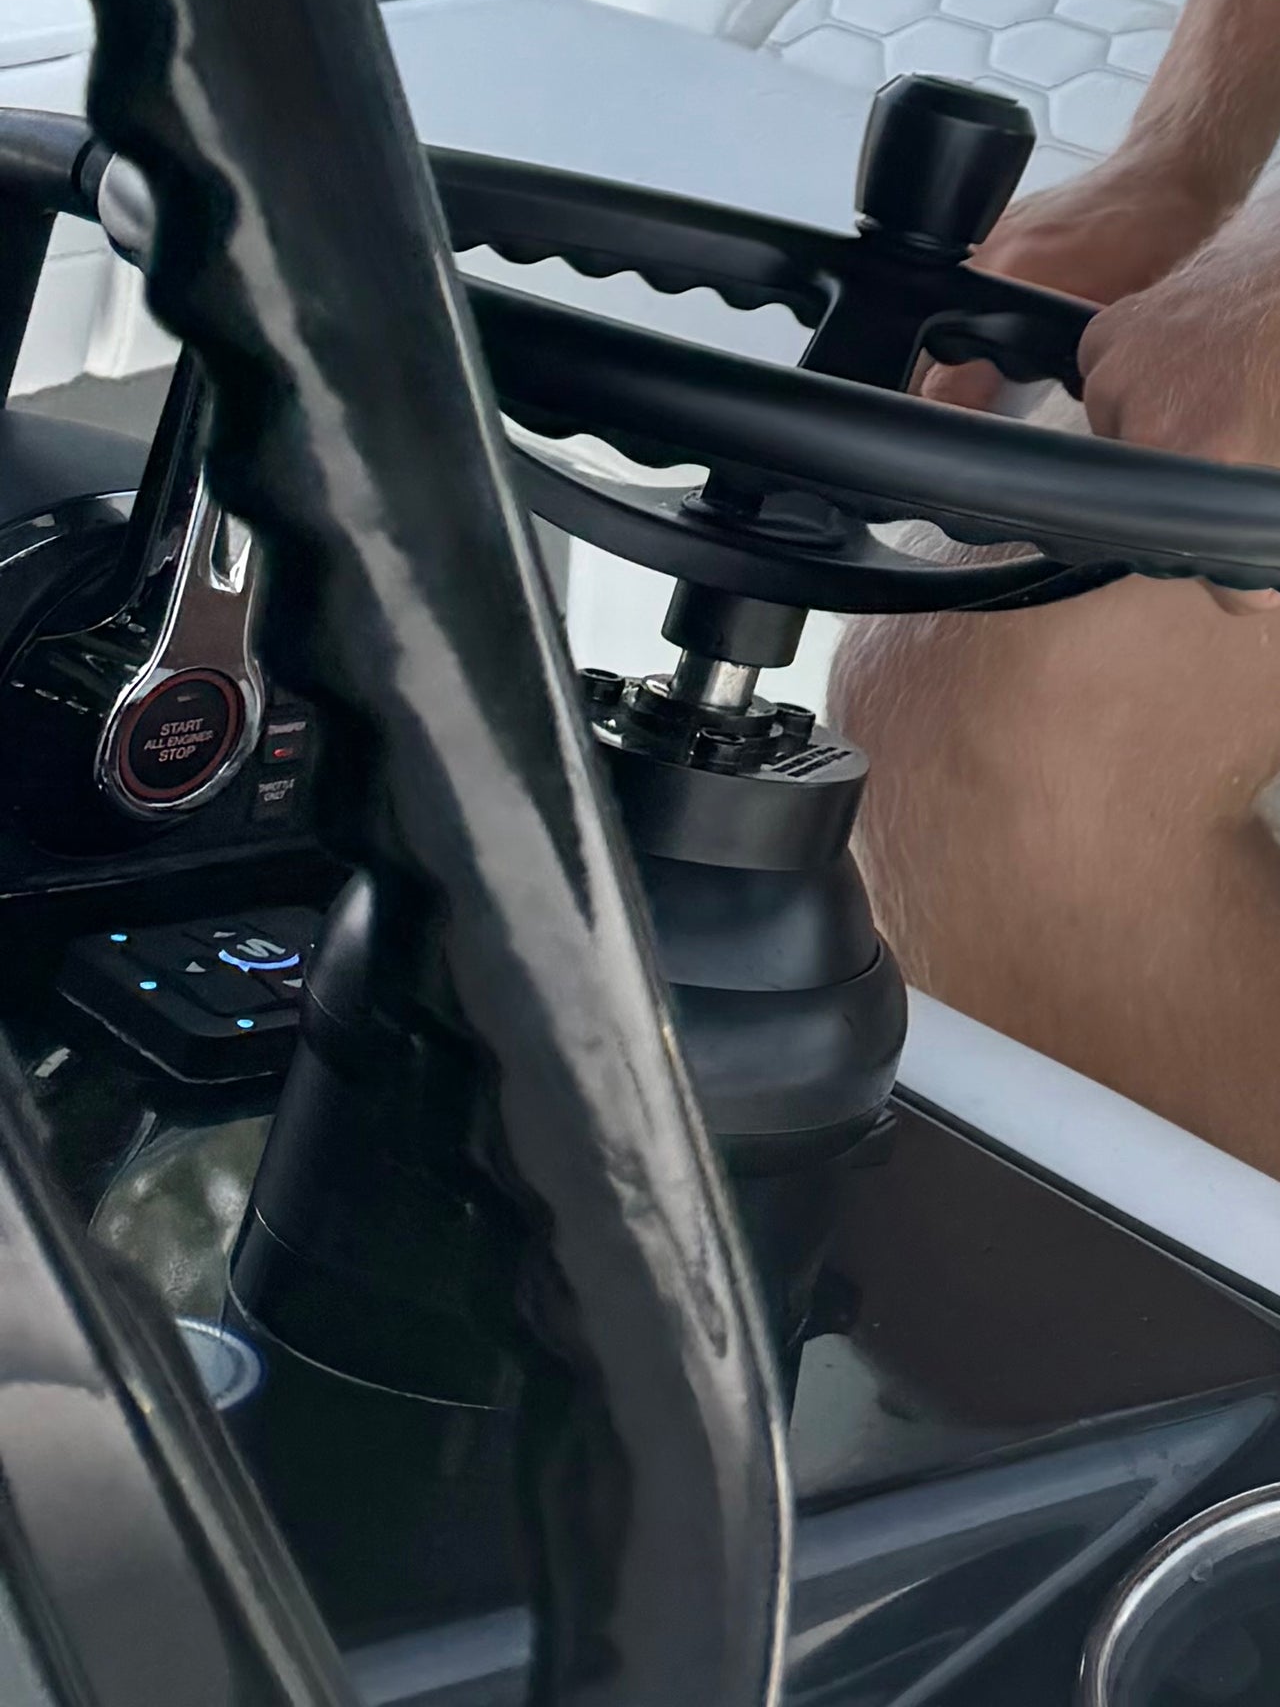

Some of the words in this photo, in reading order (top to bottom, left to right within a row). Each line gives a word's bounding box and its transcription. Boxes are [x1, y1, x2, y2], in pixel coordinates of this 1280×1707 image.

[160, 718, 204, 736] START
[143, 738, 166, 750] ALL
[158, 745, 196, 762] STOP
